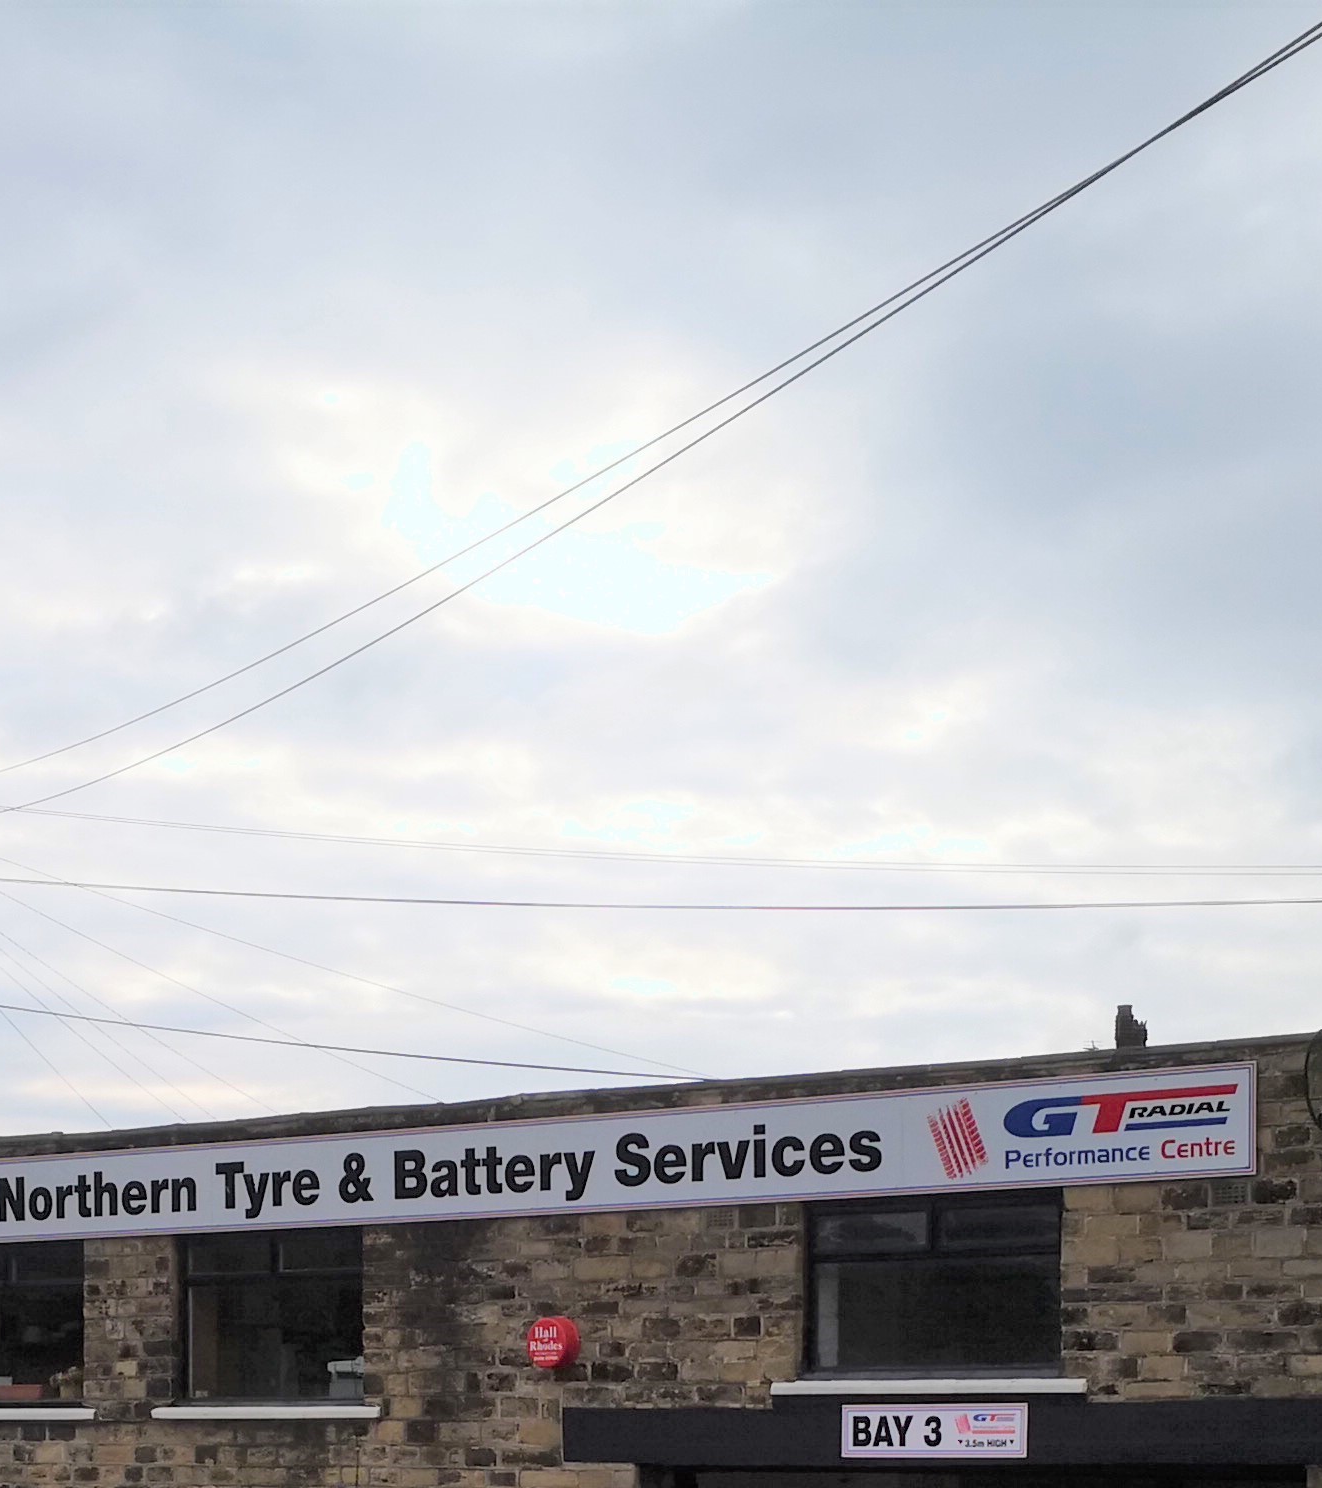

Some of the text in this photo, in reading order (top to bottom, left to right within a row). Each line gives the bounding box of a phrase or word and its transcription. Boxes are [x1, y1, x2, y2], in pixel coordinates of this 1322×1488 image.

[1003, 1084, 1238, 1138] GT
[1128, 1099, 1231, 1121] RADIAL
[1004, 1138, 1236, 1170] Performance Centre
[215, 1161, 320, 1219] Tyre
[338, 1153, 375, 1202] &
[393, 1145, 595, 1201] Battery
[614, 1124, 883, 1187] Services
[530, 1341, 563, 1351] Rhodes
[534, 1327, 557, 1338] Hall
[852, 1415, 942, 1447] BAY 3
[987, 1439, 1007, 1447] HIGH
